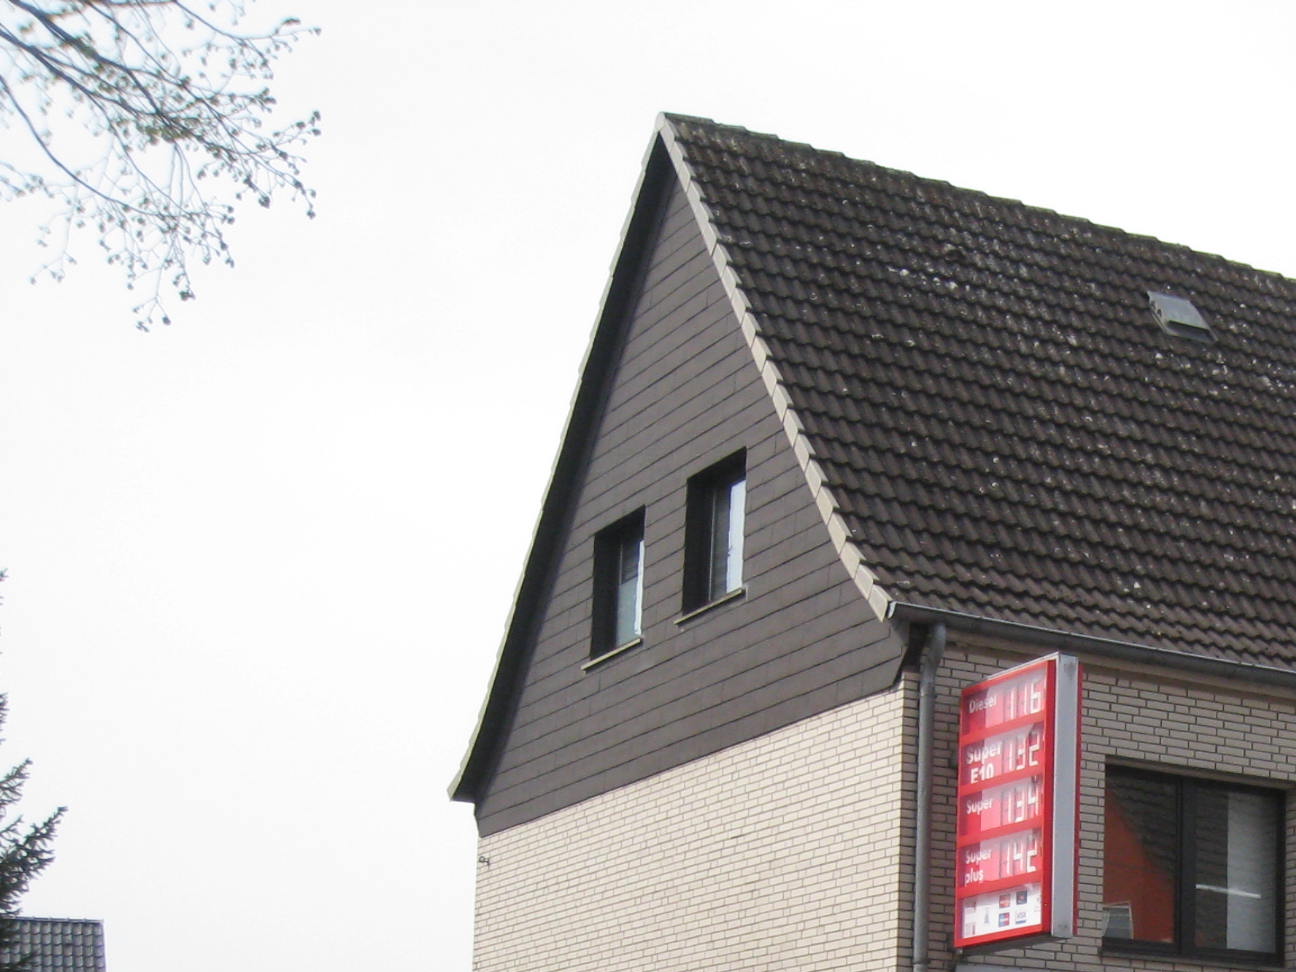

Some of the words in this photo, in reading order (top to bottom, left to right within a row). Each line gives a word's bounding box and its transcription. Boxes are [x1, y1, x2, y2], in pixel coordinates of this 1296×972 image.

[969, 695, 997, 714] Diesel
[966, 741, 1002, 765] Super
[970, 763, 995, 784] E10
[966, 799, 993, 815] Super
[965, 849, 992, 866] Super
[964, 867, 984, 887] plus
